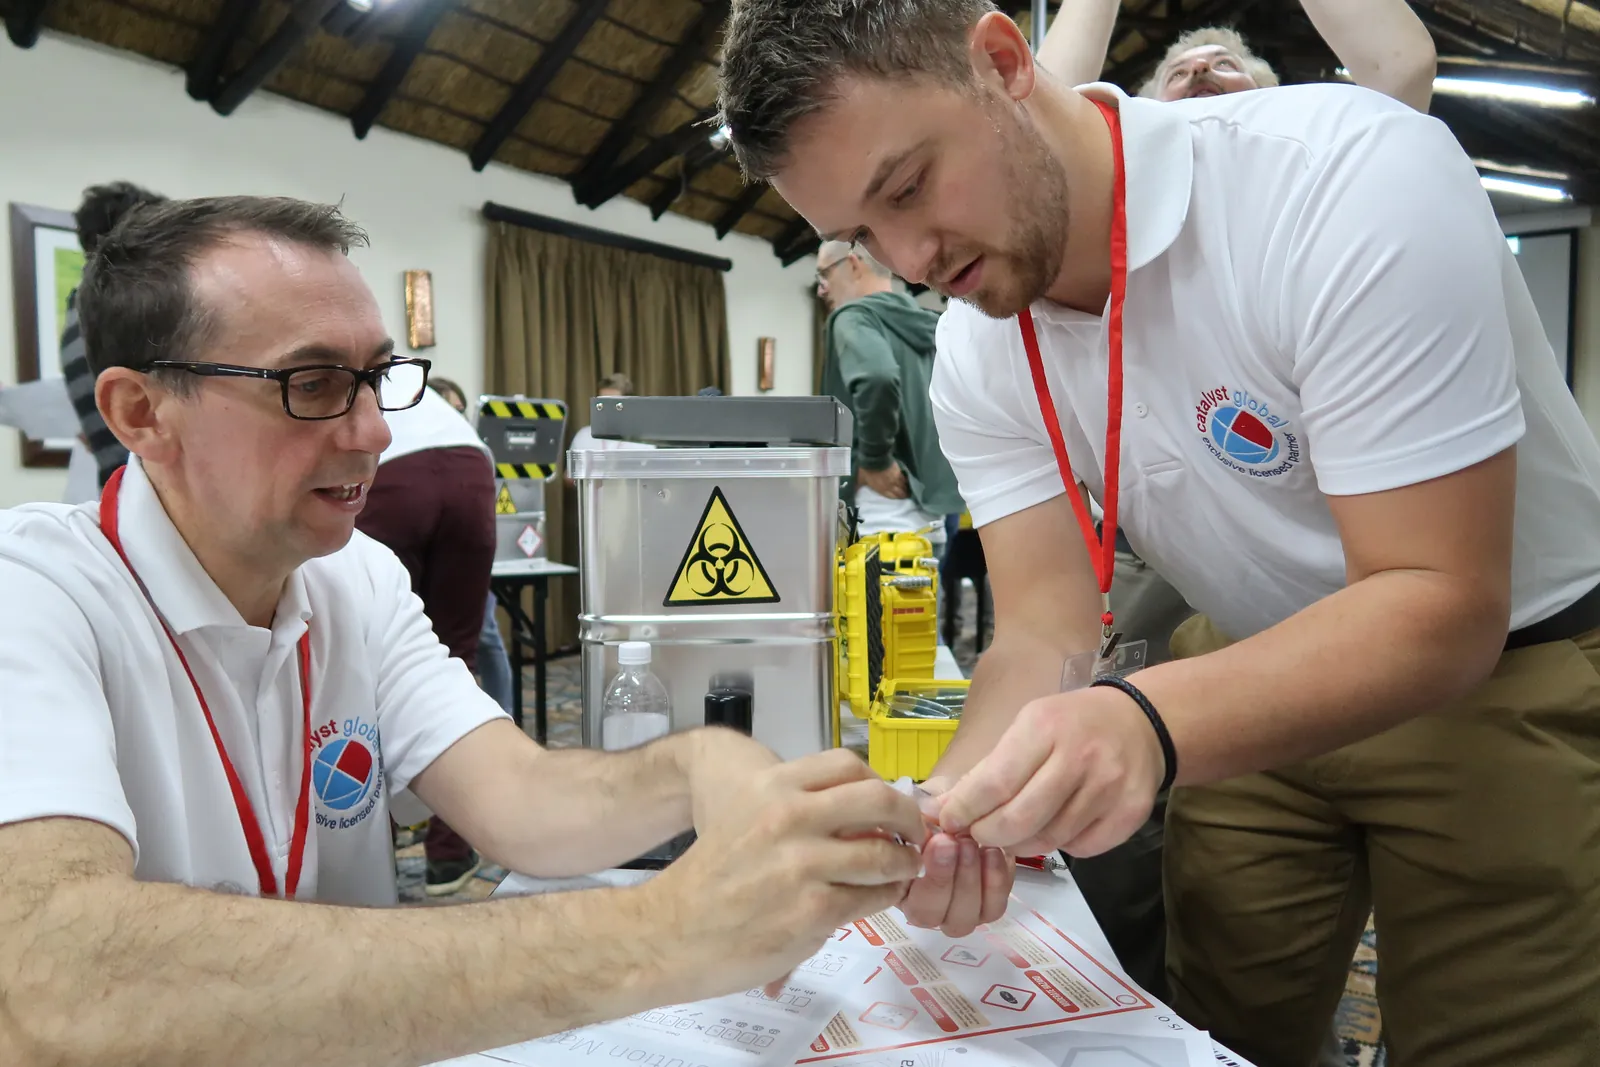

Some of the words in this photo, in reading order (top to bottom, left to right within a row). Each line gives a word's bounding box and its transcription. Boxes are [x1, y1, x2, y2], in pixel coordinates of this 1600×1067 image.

[1195, 385, 1230, 433] catalyst
[1233, 390, 1290, 428] global
[1202, 437, 1246, 474] exclusive
[1248, 460, 1293, 477] licensed
[1283, 431, 1300, 463] partner
[343, 716, 380, 754] globa
[315, 810, 337, 830] sive
[338, 800, 376, 830] licensed
